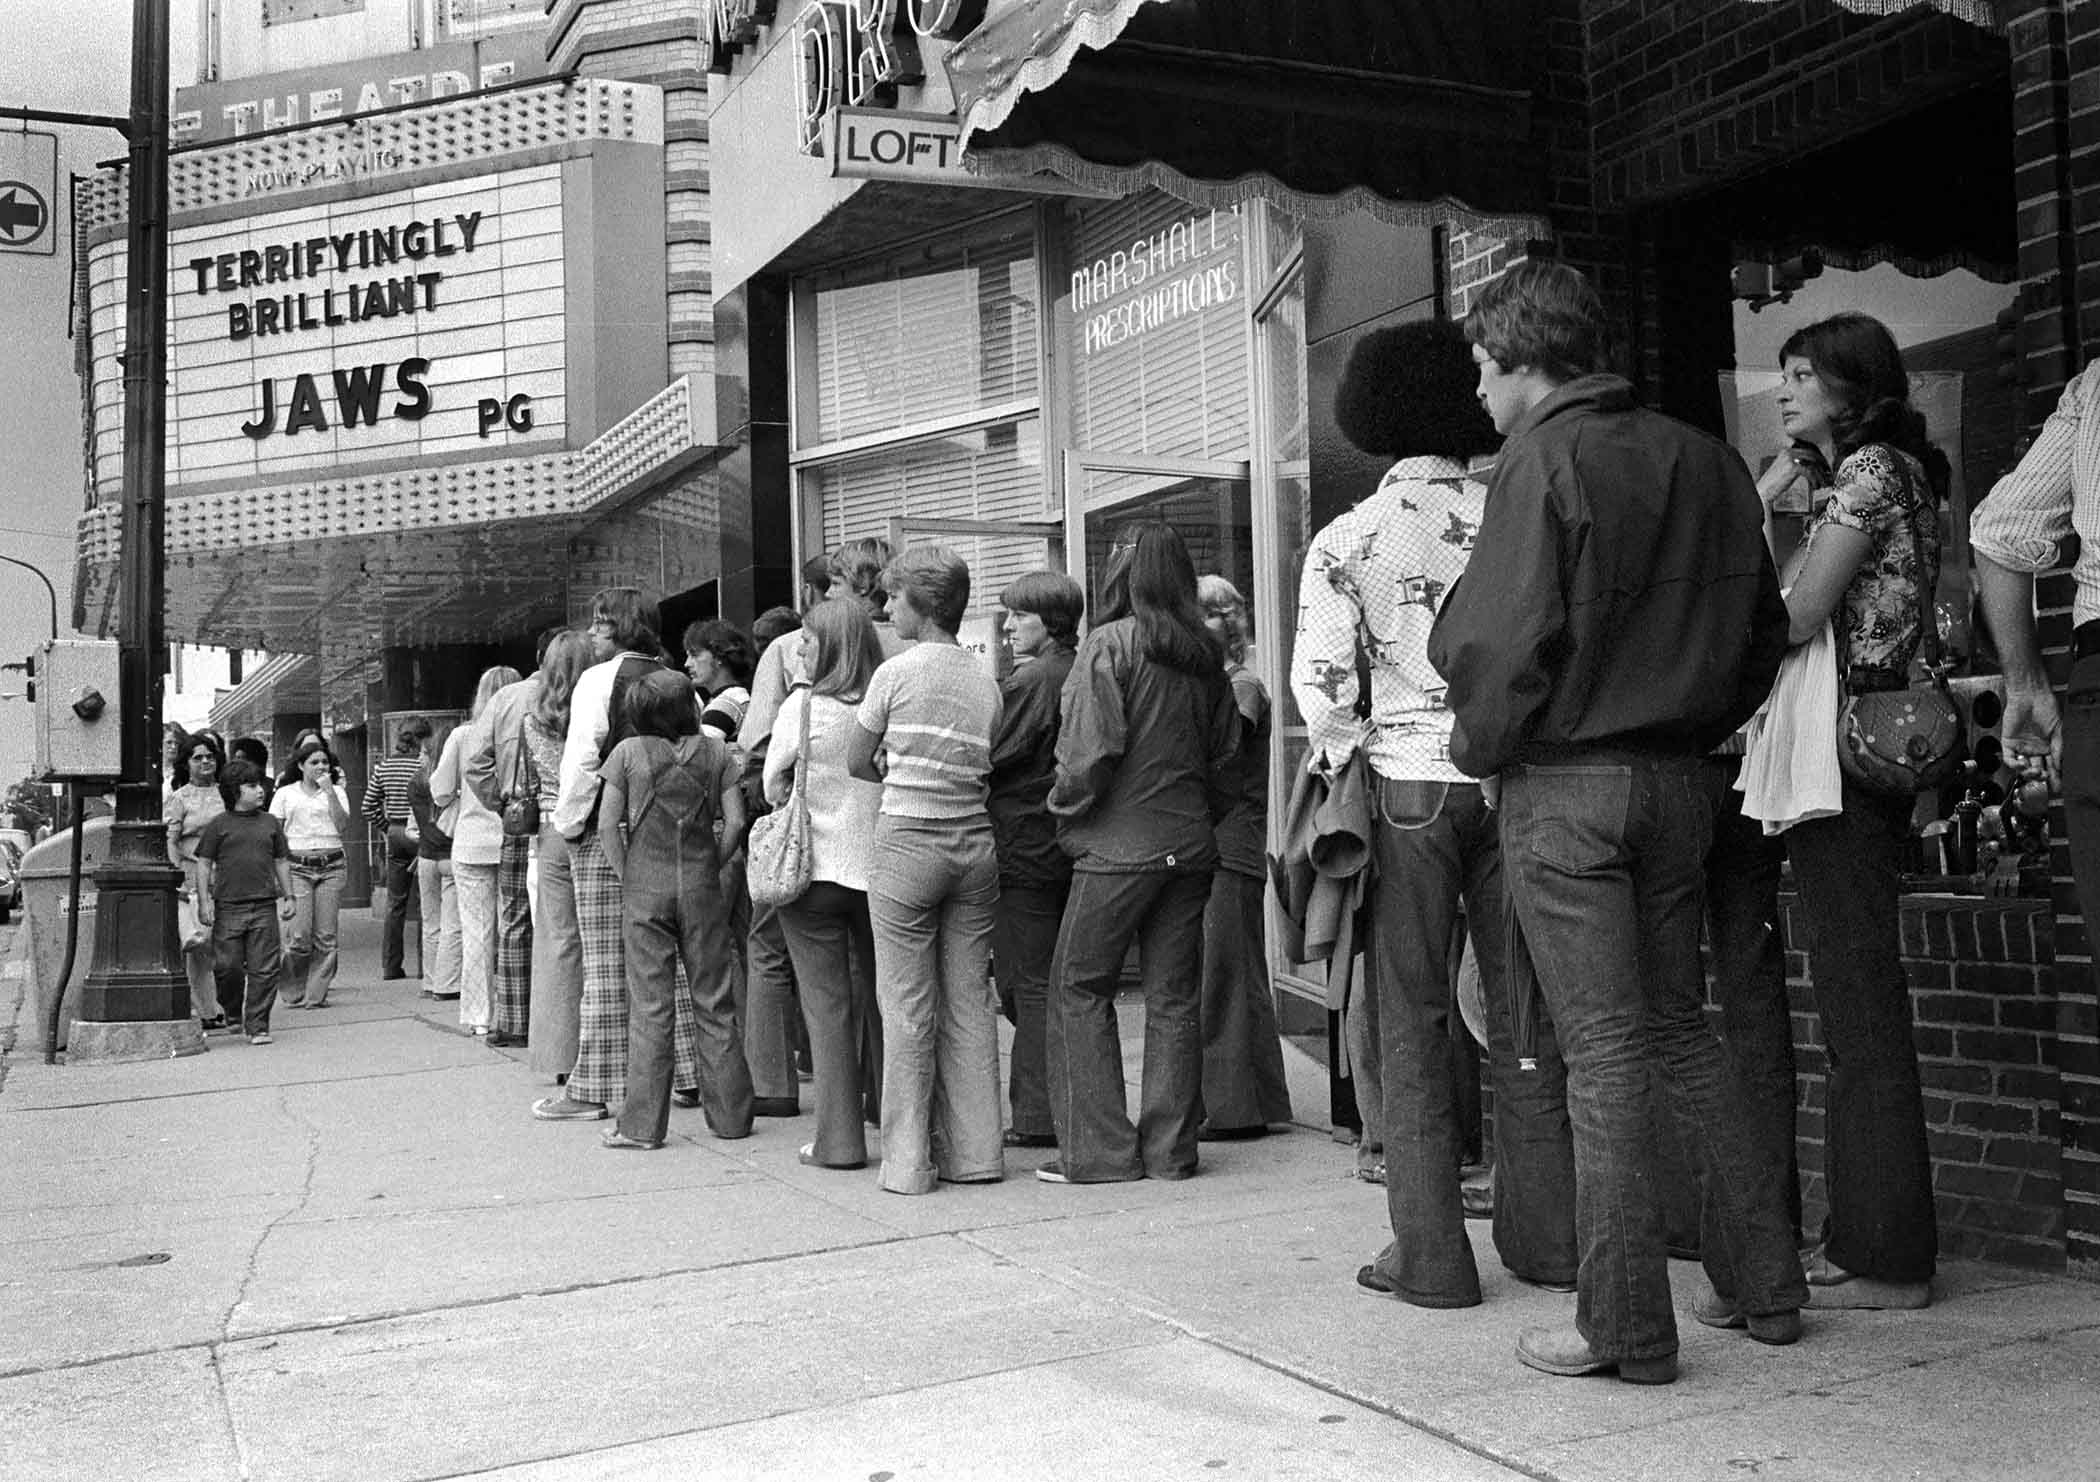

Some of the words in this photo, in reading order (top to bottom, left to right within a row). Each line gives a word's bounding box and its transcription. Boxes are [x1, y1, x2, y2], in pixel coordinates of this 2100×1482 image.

[247, 168, 295, 196] NOW
[304, 150, 403, 185] PLAYING
[190, 211, 482, 296] TERRIFYINGLY
[230, 271, 443, 341] BRILLIANT
[1085, 259, 1237, 354] PRESCRIPTIONS
[241, 357, 433, 440] JAWS
[478, 392, 534, 439] PG
